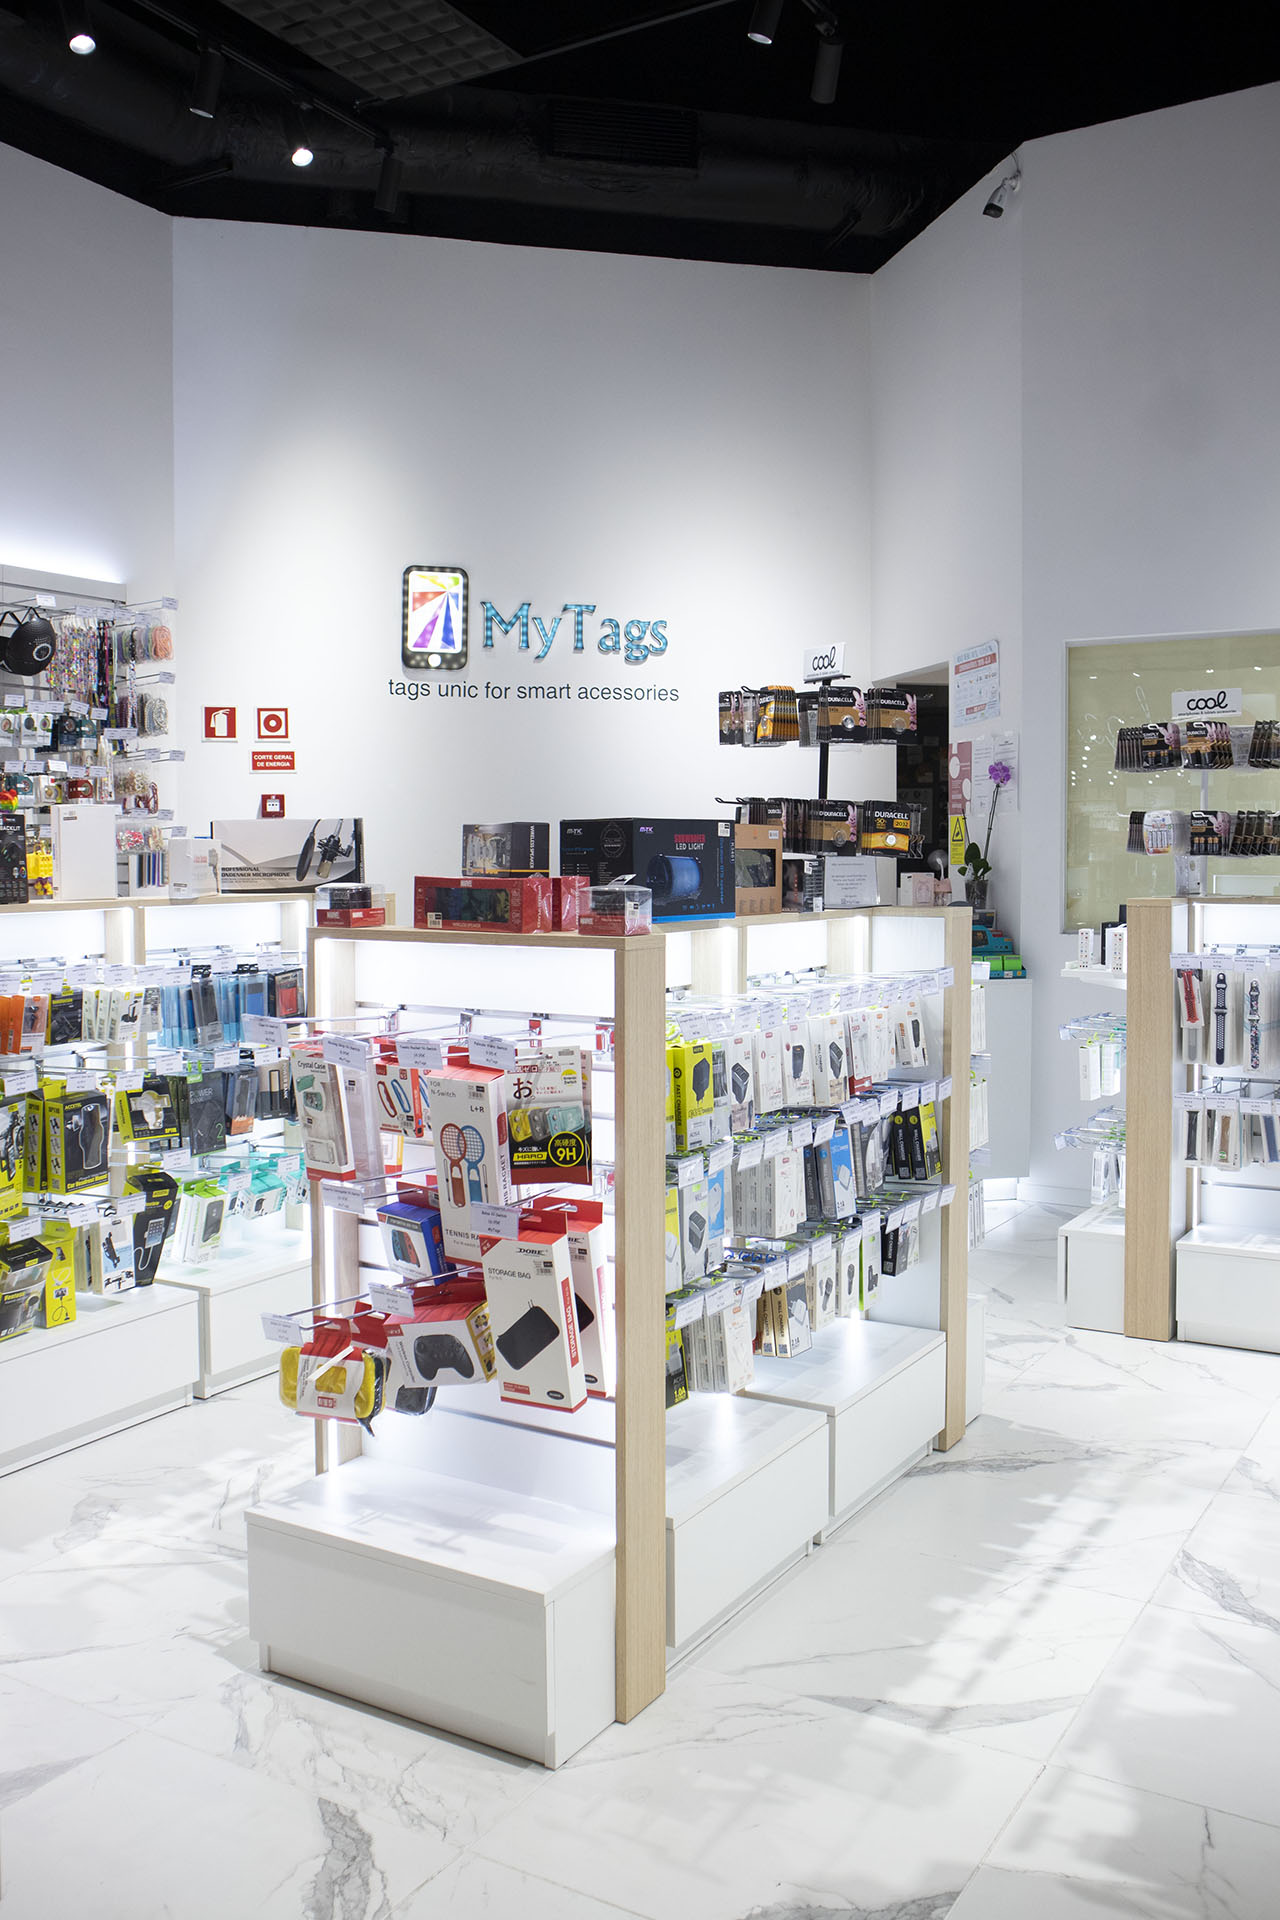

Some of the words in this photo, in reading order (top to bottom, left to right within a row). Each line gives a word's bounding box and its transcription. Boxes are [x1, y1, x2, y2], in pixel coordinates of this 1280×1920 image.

[480, 601, 669, 663] MyTags
[812, 646, 836, 671] cool
[389, 679, 431, 701] tags
[438, 681, 478, 699] unic
[485, 682, 510, 699] for
[517, 683, 571, 700] smart
[577, 684, 680, 701] acessories
[1187, 691, 1228, 710] cool
[874, 810, 909, 820] DURACELL
[297, 1060, 313, 1069] Crystal
[513, 1078, 532, 1099] お
[215, 1123, 223, 1139] 2
[557, 1147, 577, 1161] 9H
[445, 1229, 469, 1240] TENNIS
[488, 1267, 516, 1278] STORAGE
